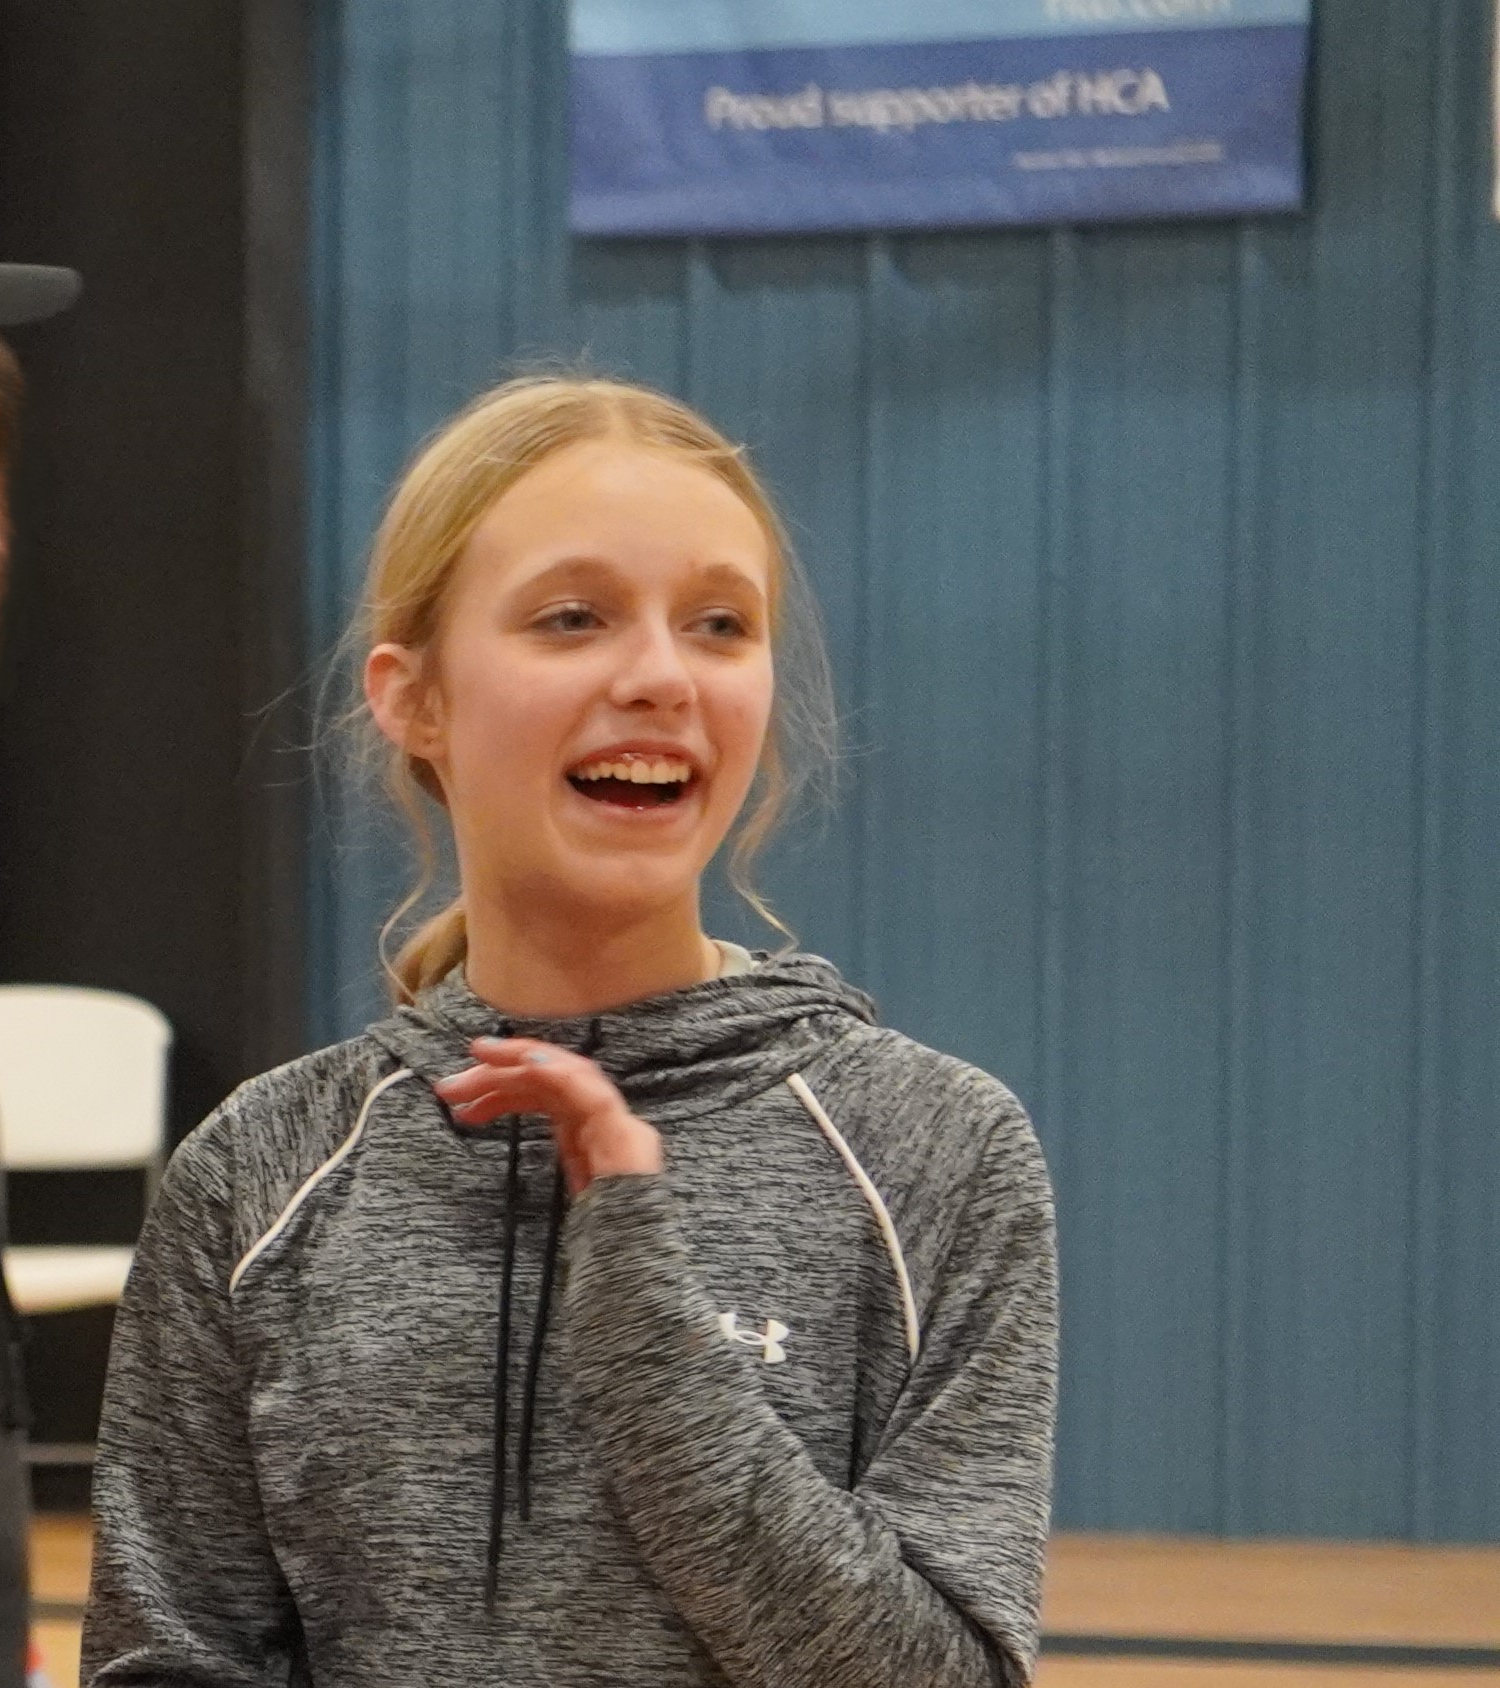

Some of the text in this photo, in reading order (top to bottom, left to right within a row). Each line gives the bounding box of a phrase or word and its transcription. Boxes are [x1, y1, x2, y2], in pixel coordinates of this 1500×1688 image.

[706, 67, 1171, 134] Proud supporter of HCA
